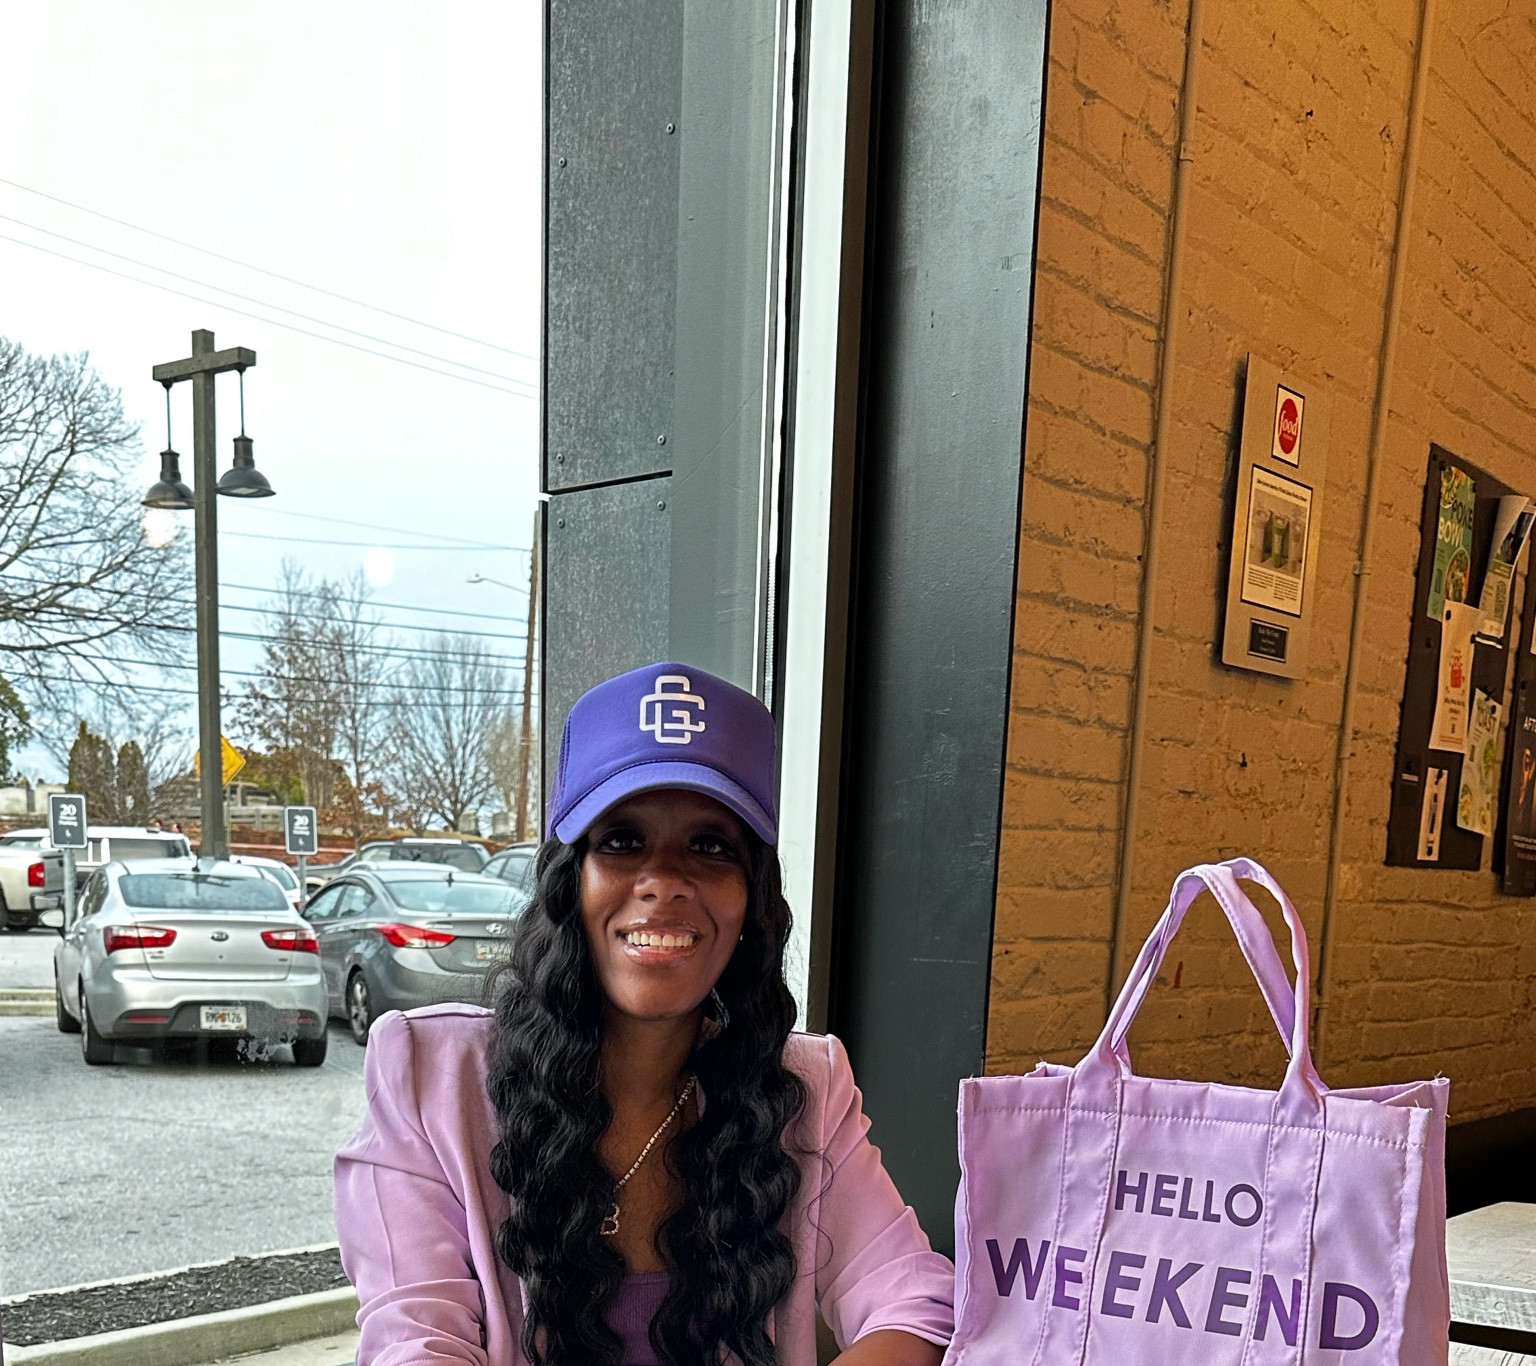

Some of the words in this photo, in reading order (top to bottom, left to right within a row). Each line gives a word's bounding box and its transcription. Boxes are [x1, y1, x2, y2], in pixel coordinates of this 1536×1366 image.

[1279, 410, 1299, 436] food
[1451, 499, 1473, 530] POKE
[59, 803, 77, 816] 20
[293, 814, 310, 826] 20
[1115, 1170, 1263, 1227] HELLO
[986, 1237, 1380, 1351] WEEKEND
